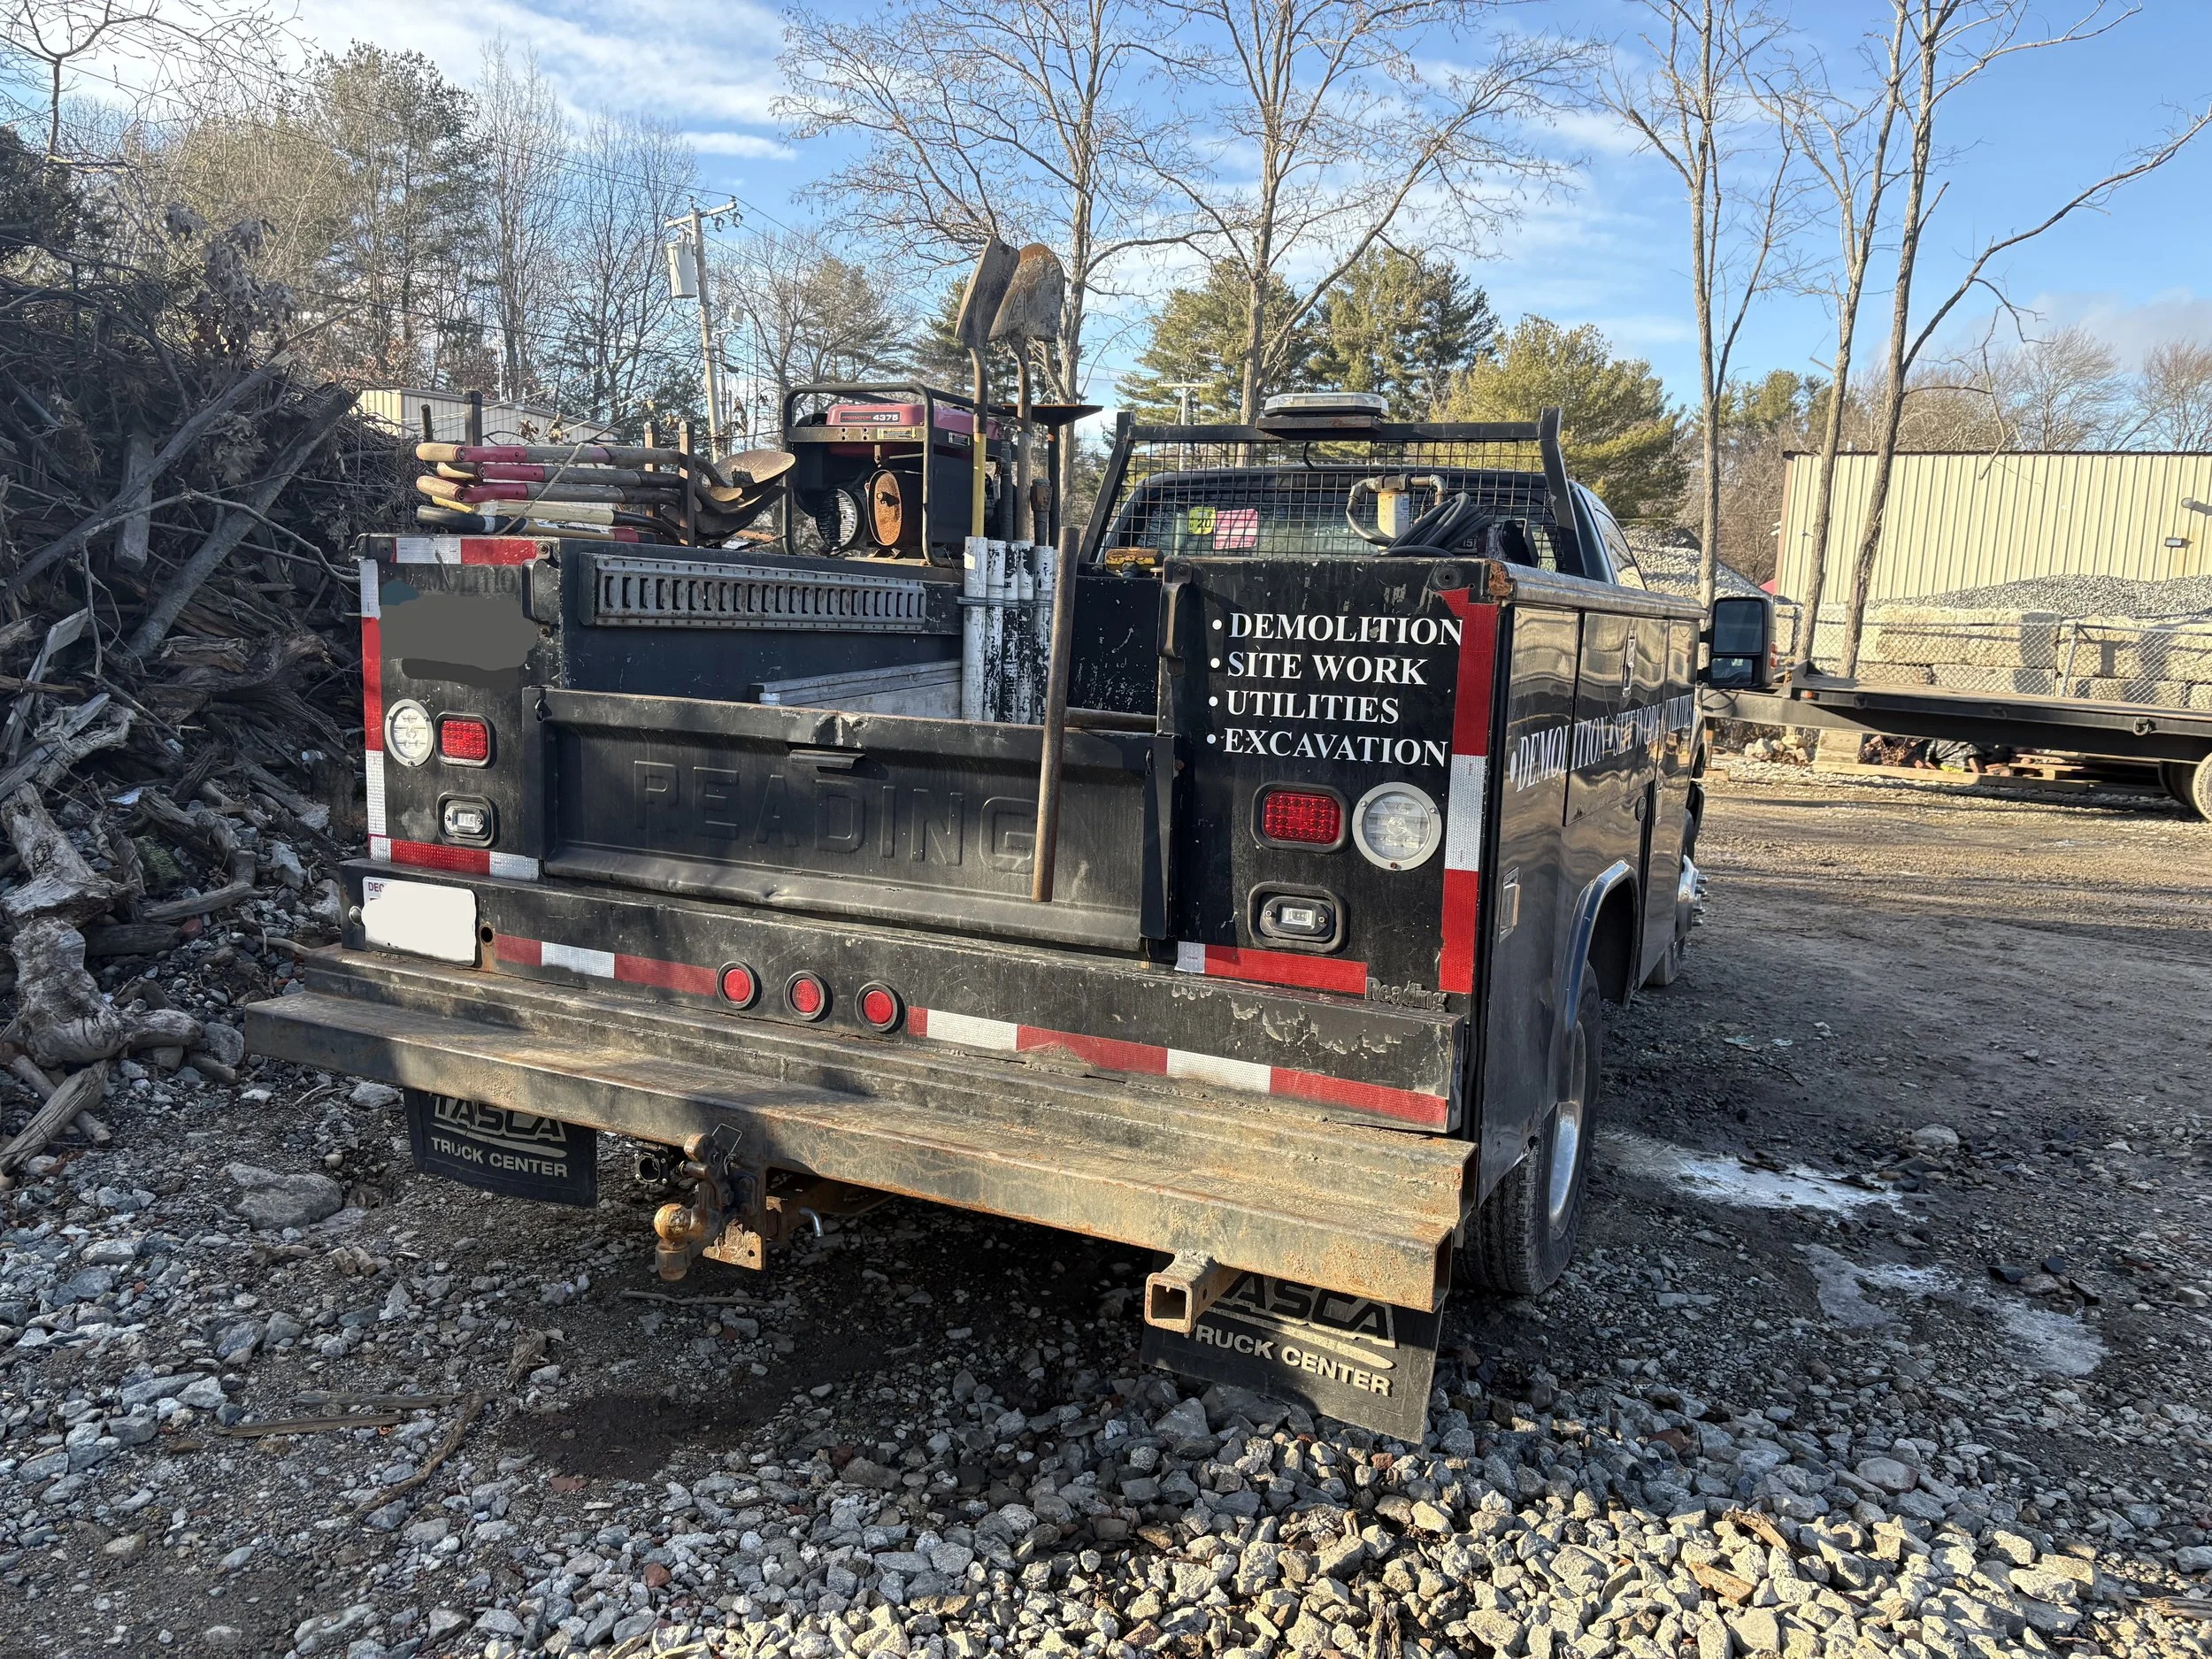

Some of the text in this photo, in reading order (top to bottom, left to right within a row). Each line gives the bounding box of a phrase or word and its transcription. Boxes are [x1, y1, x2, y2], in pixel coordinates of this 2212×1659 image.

[872, 413, 899, 422] 4375
[1229, 612, 1463, 646] DEMOLITION
[1226, 651, 1428, 686] SITE WORK
[1226, 689, 1400, 725] UTILITIES
[1223, 727, 1449, 768] EXCAVATION
[1516, 716, 1609, 793] DEMOLITION
[1613, 710, 1637, 757] SITE
[1636, 703, 1663, 747] WORK
[1364, 976, 1448, 1014] Reading
[431, 1137, 568, 1179] TRUCK CENTER
[1224, 1271, 1399, 1348] ASCA
[1184, 1324, 1394, 1397] RUCK CENTER
